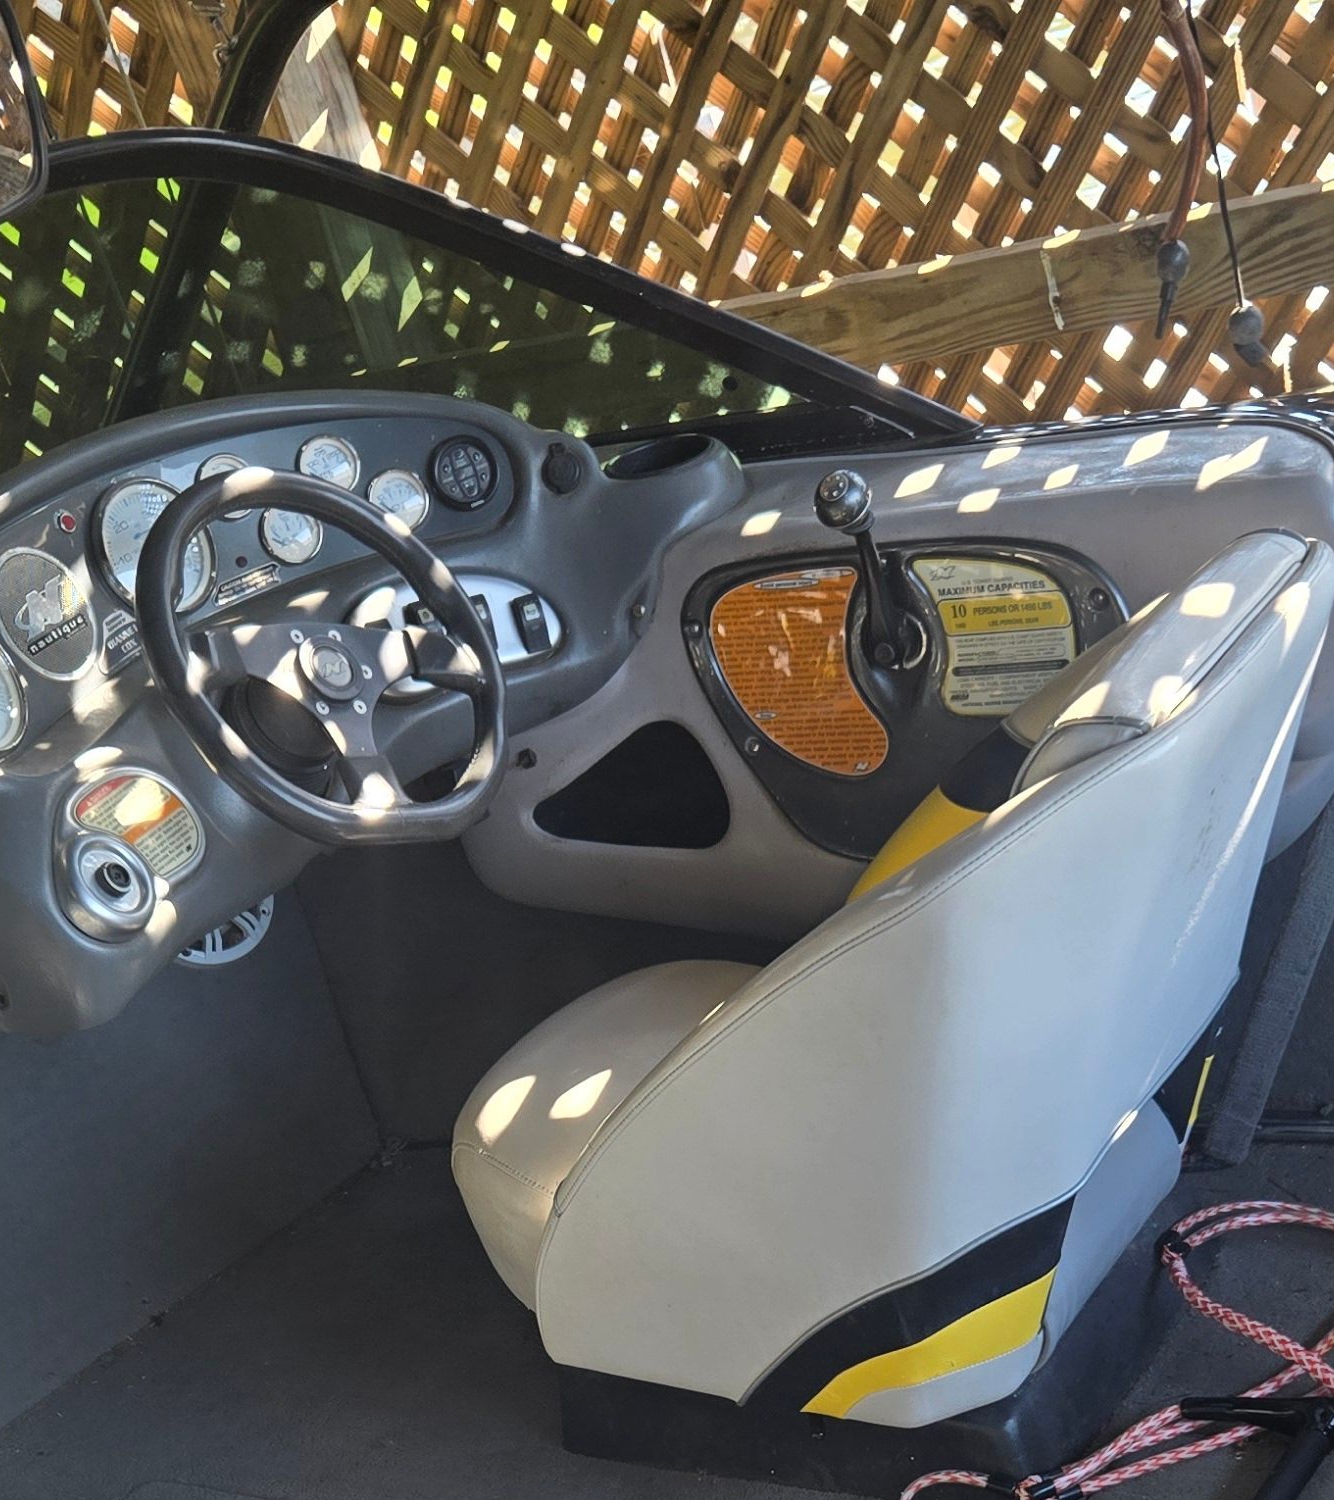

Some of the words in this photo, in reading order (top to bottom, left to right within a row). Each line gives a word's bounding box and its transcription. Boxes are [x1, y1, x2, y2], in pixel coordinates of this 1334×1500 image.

[937, 584, 985, 597] MAXIMUM
[986, 579, 1045, 593] CAPACITIES
[950, 603, 967, 619] 10
[972, 604, 1007, 616] PERSONS
[1007, 603, 1020, 613] OR
[30, 615, 84, 654] nautique
